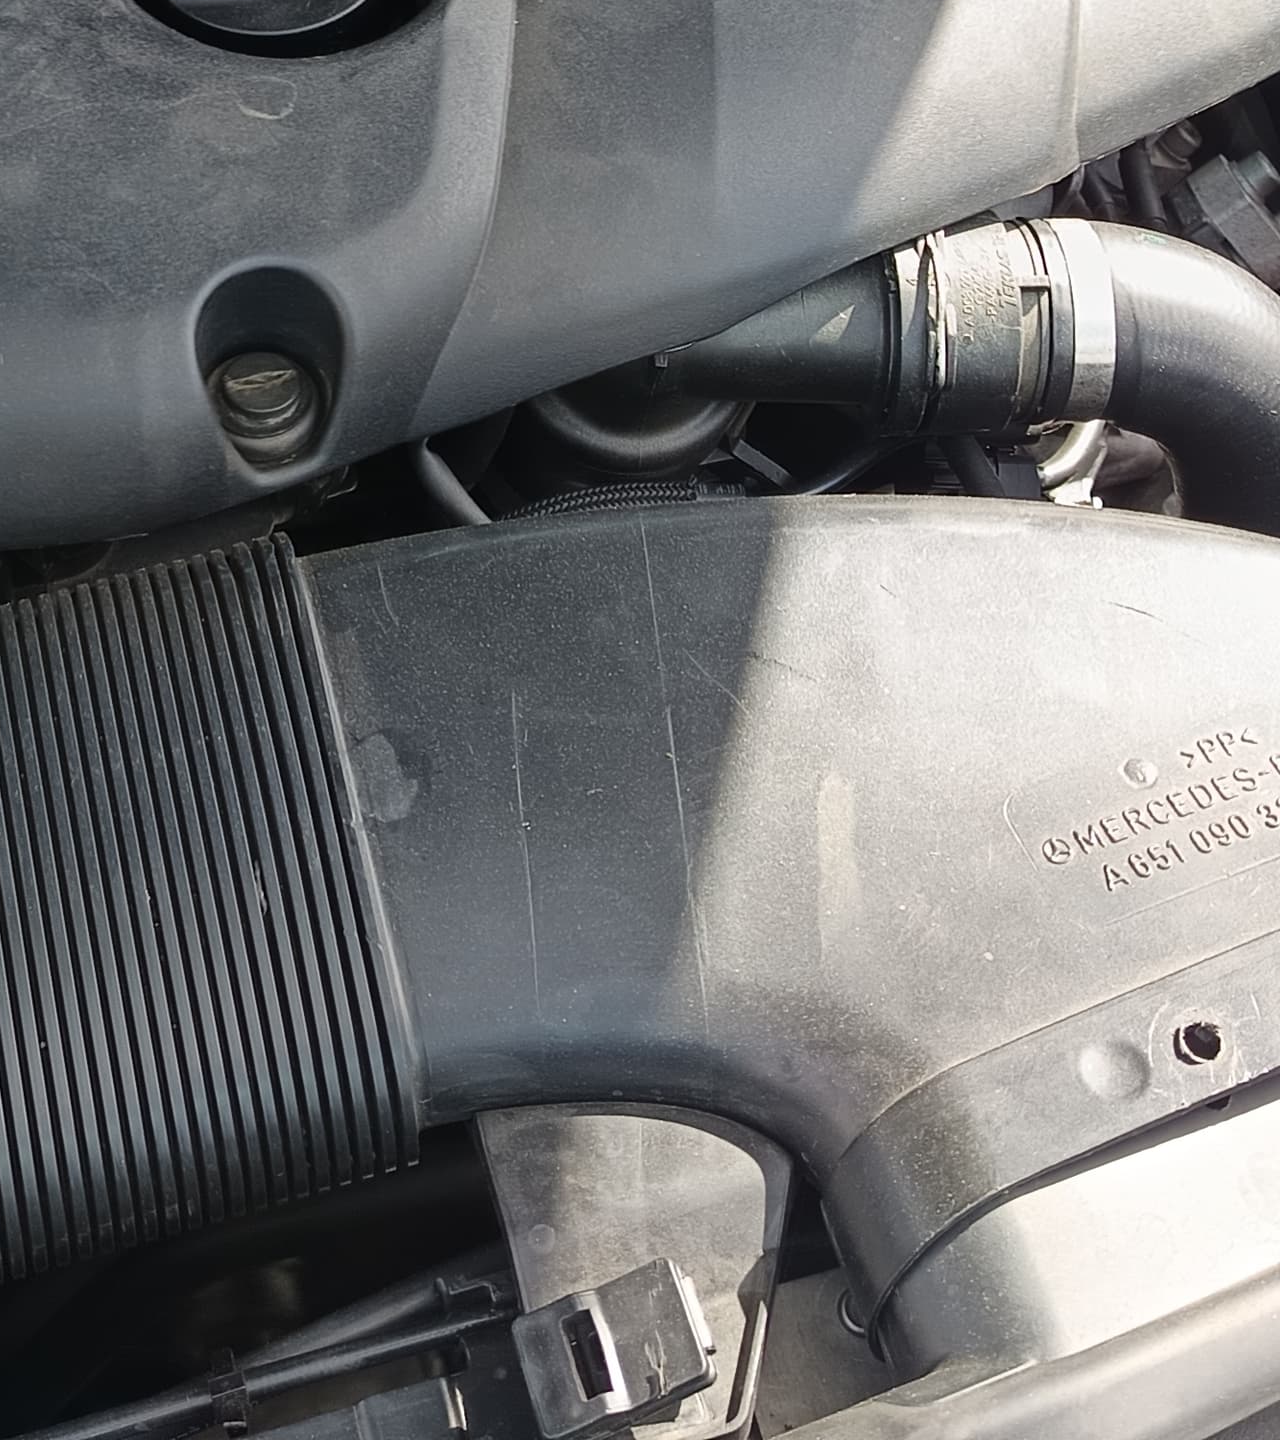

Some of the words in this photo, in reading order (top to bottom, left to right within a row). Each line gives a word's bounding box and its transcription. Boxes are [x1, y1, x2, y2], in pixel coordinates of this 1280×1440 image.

[1103, 862, 1129, 892] A
[1128, 838, 1186, 880] 651
[1189, 813, 1251, 855] 090
